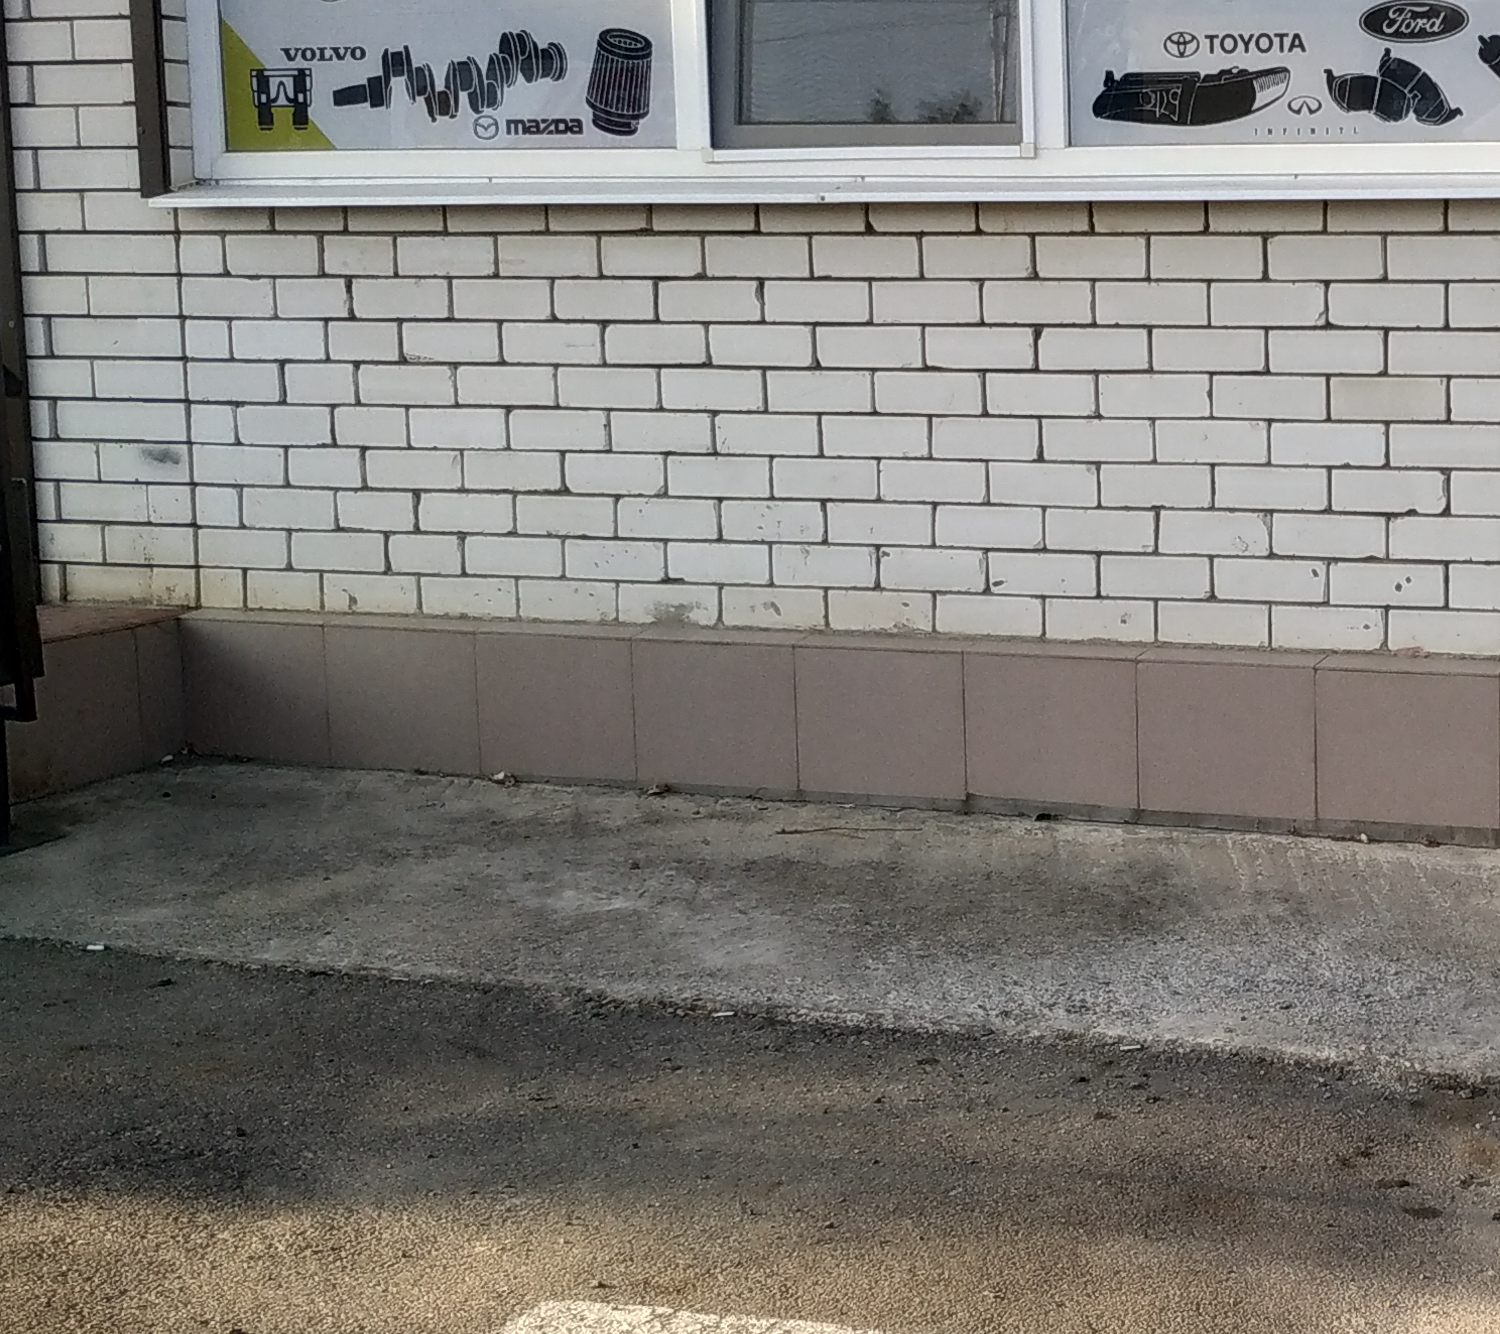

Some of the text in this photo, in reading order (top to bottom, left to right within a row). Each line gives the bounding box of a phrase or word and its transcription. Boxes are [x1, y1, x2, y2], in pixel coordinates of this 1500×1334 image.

[1382, 5, 1446, 34] Ford
[280, 46, 367, 63] VOLVO
[1204, 32, 1307, 55] TOYOTA
